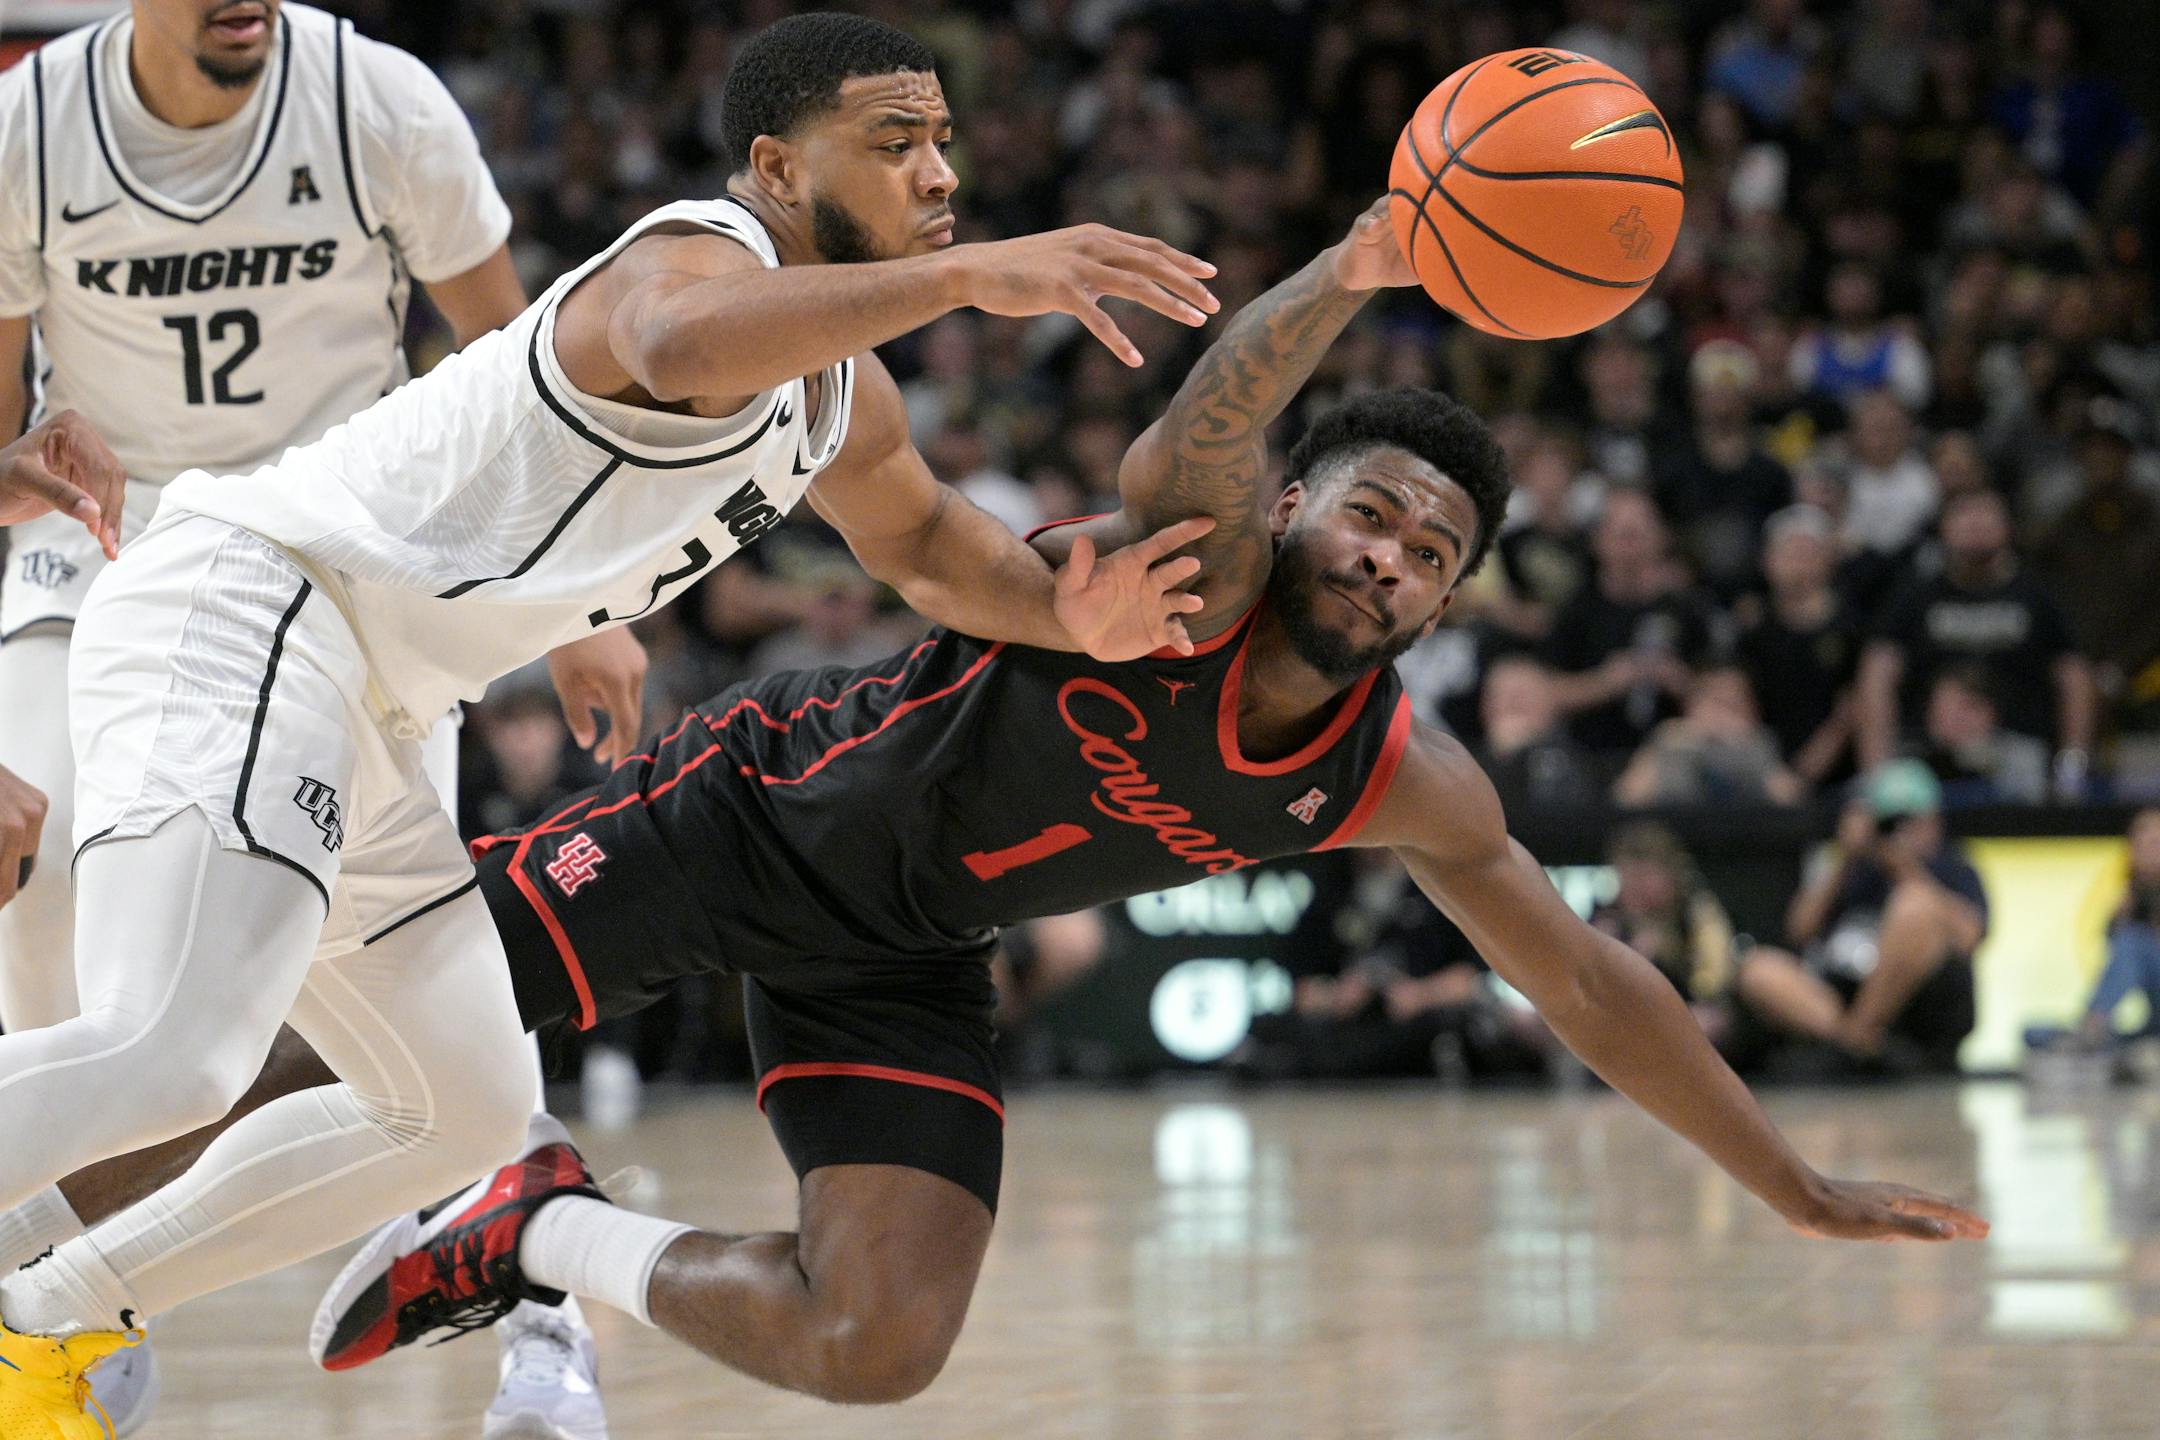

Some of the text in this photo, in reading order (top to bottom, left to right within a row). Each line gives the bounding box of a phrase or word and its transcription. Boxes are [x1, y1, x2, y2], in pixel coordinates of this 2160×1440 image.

[75, 239, 337, 296] KNIGHTS
[163, 309, 264, 404] 12
[1057, 677, 1262, 874] Cougars
[293, 776, 344, 853] UCF
[961, 823, 1092, 881] 1
